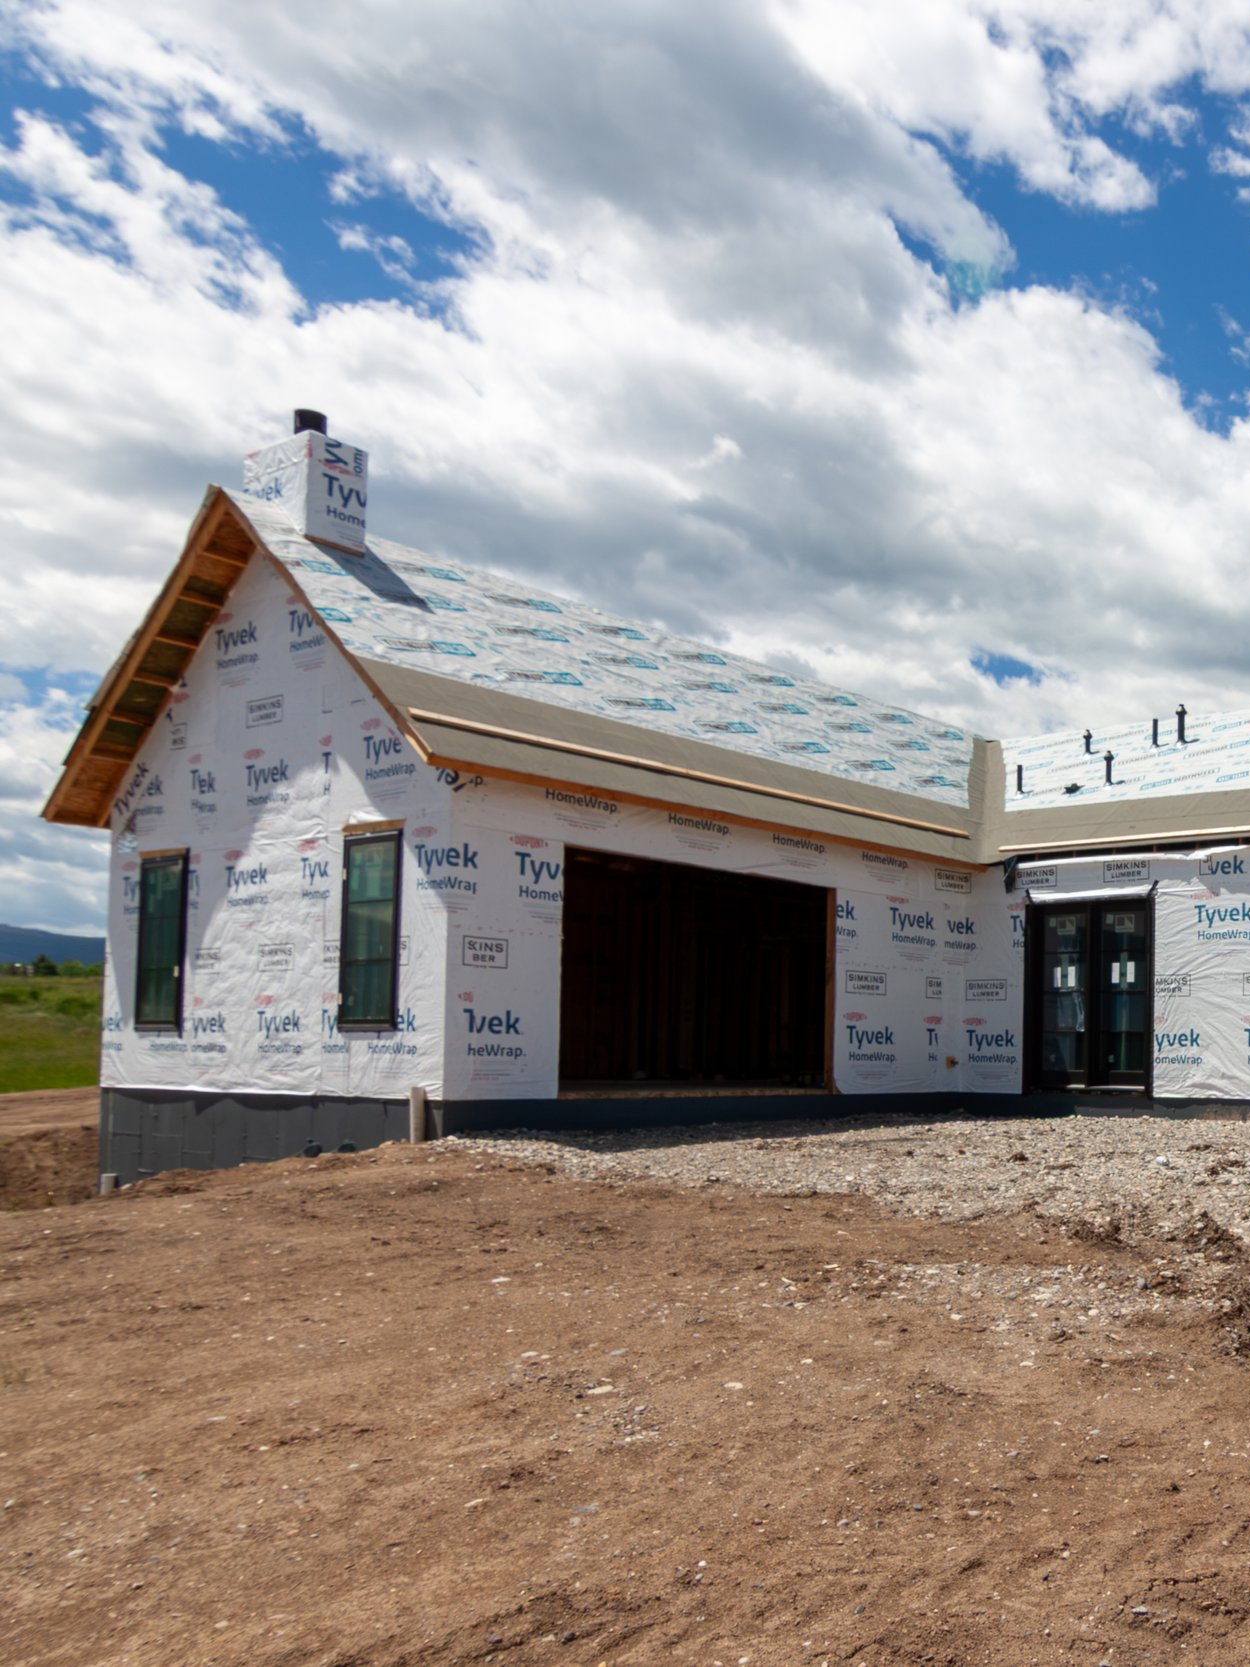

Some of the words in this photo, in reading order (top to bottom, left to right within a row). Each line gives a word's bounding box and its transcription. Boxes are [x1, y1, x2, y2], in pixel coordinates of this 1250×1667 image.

[215, 621, 257, 654] Tyvek
[245, 759, 288, 791] Tyvek
[365, 762, 416, 780] HomeWrap
[545, 787, 618, 815] HomeWrap
[668, 812, 730, 836] HomeWrap
[773, 832, 825, 854] HomeWrap
[415, 842, 478, 875] Tyvek
[862, 851, 908, 869] HomeWrap
[1106, 861, 1147, 872] SIMKINS
[515, 852, 561, 884] Tyv
[937, 871, 970, 883] SIMKINS
[1016, 869, 1055, 878] SIMKINS
[1111, 870, 1142, 879] LUMBER
[225, 863, 267, 892] Tyvek
[941, 880, 965, 890] LUMBER
[1021, 878, 1049, 886] LUMBER
[890, 906, 934, 931] Tyvek
[892, 931, 936, 947] HomeWrap
[848, 973, 884, 985] SIMKINS
[853, 982, 880, 992] LUMBER
[968, 981, 1005, 991] SIMKINS
[972, 990, 1000, 998] LUMBER
[257, 1008, 300, 1039] Tyvek
[846, 1025, 894, 1050] Tyvek
[966, 1028, 1015, 1052] Tyvek
[848, 1050, 895, 1064] HomeWrap
[968, 1053, 1017, 1065] HomeWrap
